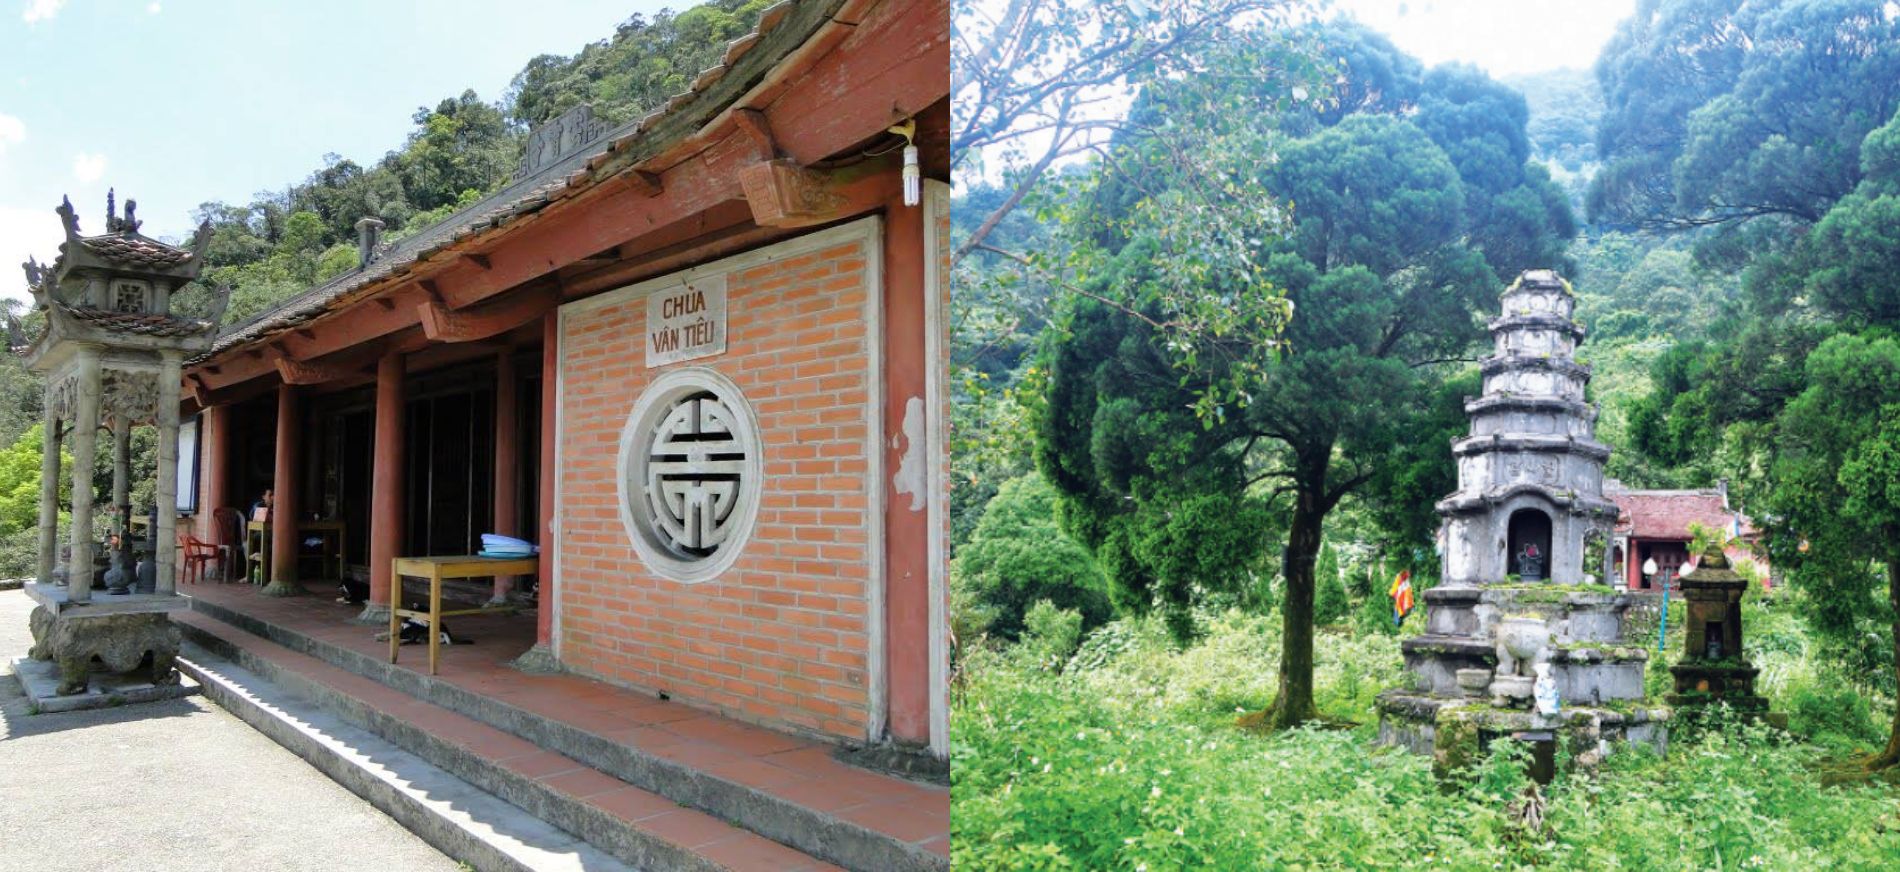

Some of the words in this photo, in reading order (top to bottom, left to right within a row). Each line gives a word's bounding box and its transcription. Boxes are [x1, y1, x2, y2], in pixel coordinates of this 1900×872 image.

[663, 284, 706, 319] CHÙA
[652, 325, 680, 353] VÂN
[683, 316, 714, 348] TIÊU
